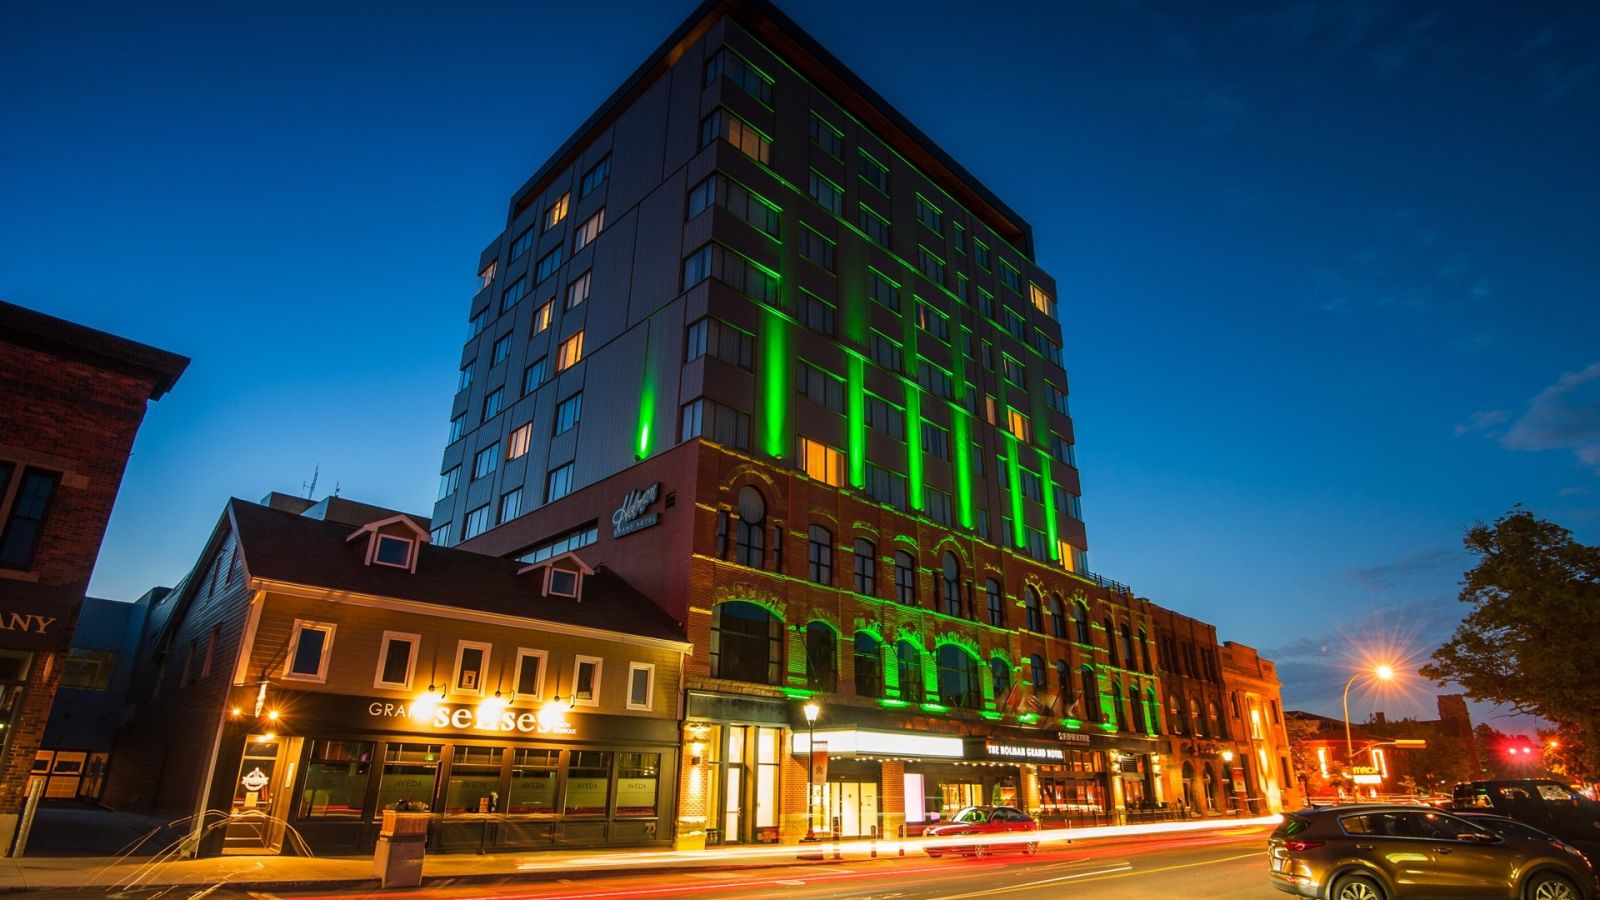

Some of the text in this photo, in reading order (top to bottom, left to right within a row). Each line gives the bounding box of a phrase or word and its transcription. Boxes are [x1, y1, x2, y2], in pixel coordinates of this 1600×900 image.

[433, 706, 553, 734] seses
[988, 745, 1064, 759] THE HOLMAN GRAND HOTEL
